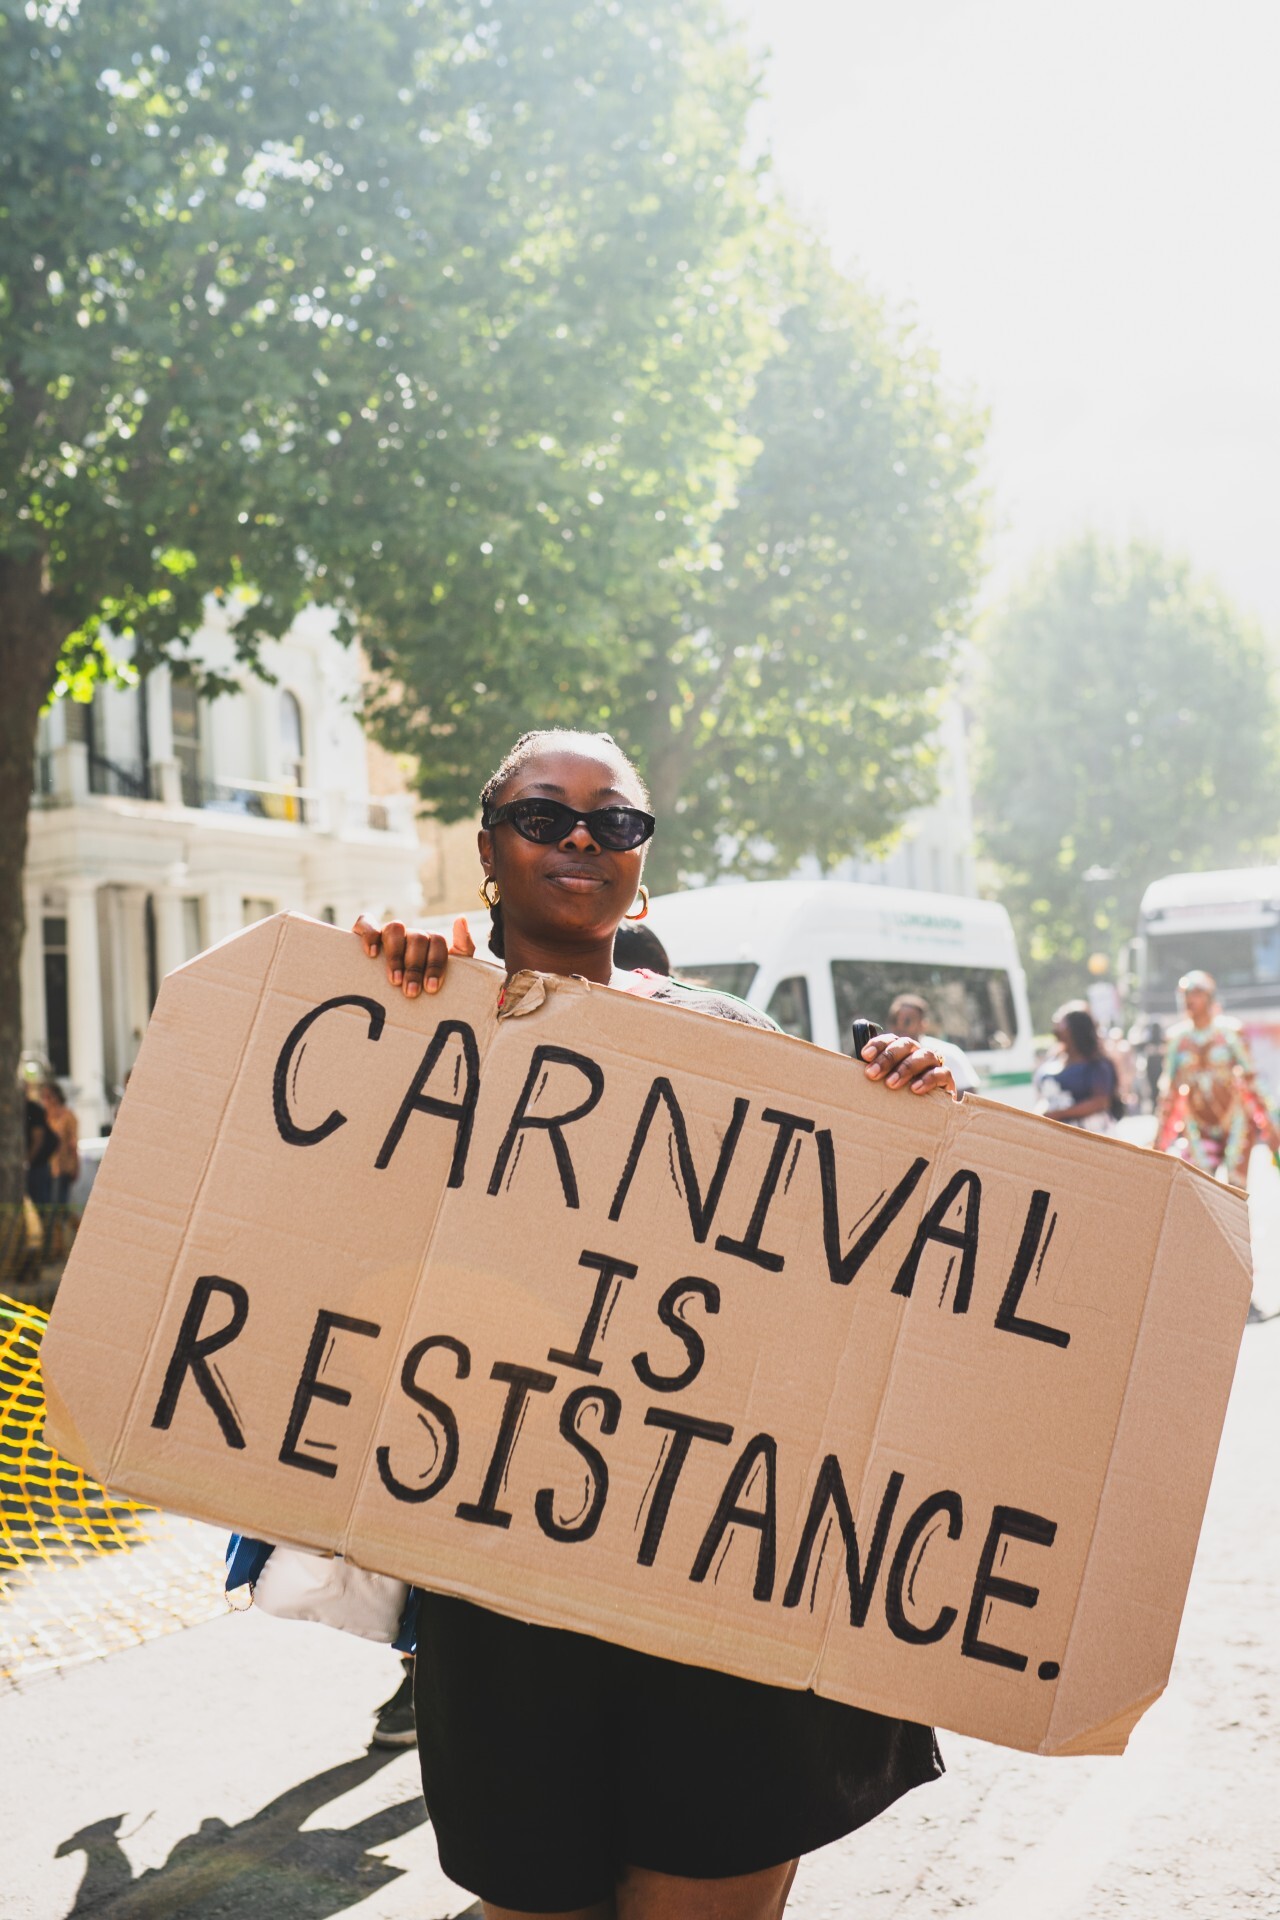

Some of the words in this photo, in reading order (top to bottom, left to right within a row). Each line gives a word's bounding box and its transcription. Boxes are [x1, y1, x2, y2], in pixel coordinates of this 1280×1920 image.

[273, 995, 1070, 1350] CARNIVAL
[548, 1250, 721, 1393] IS
[151, 1275, 1061, 1681] RESISTANCE.
